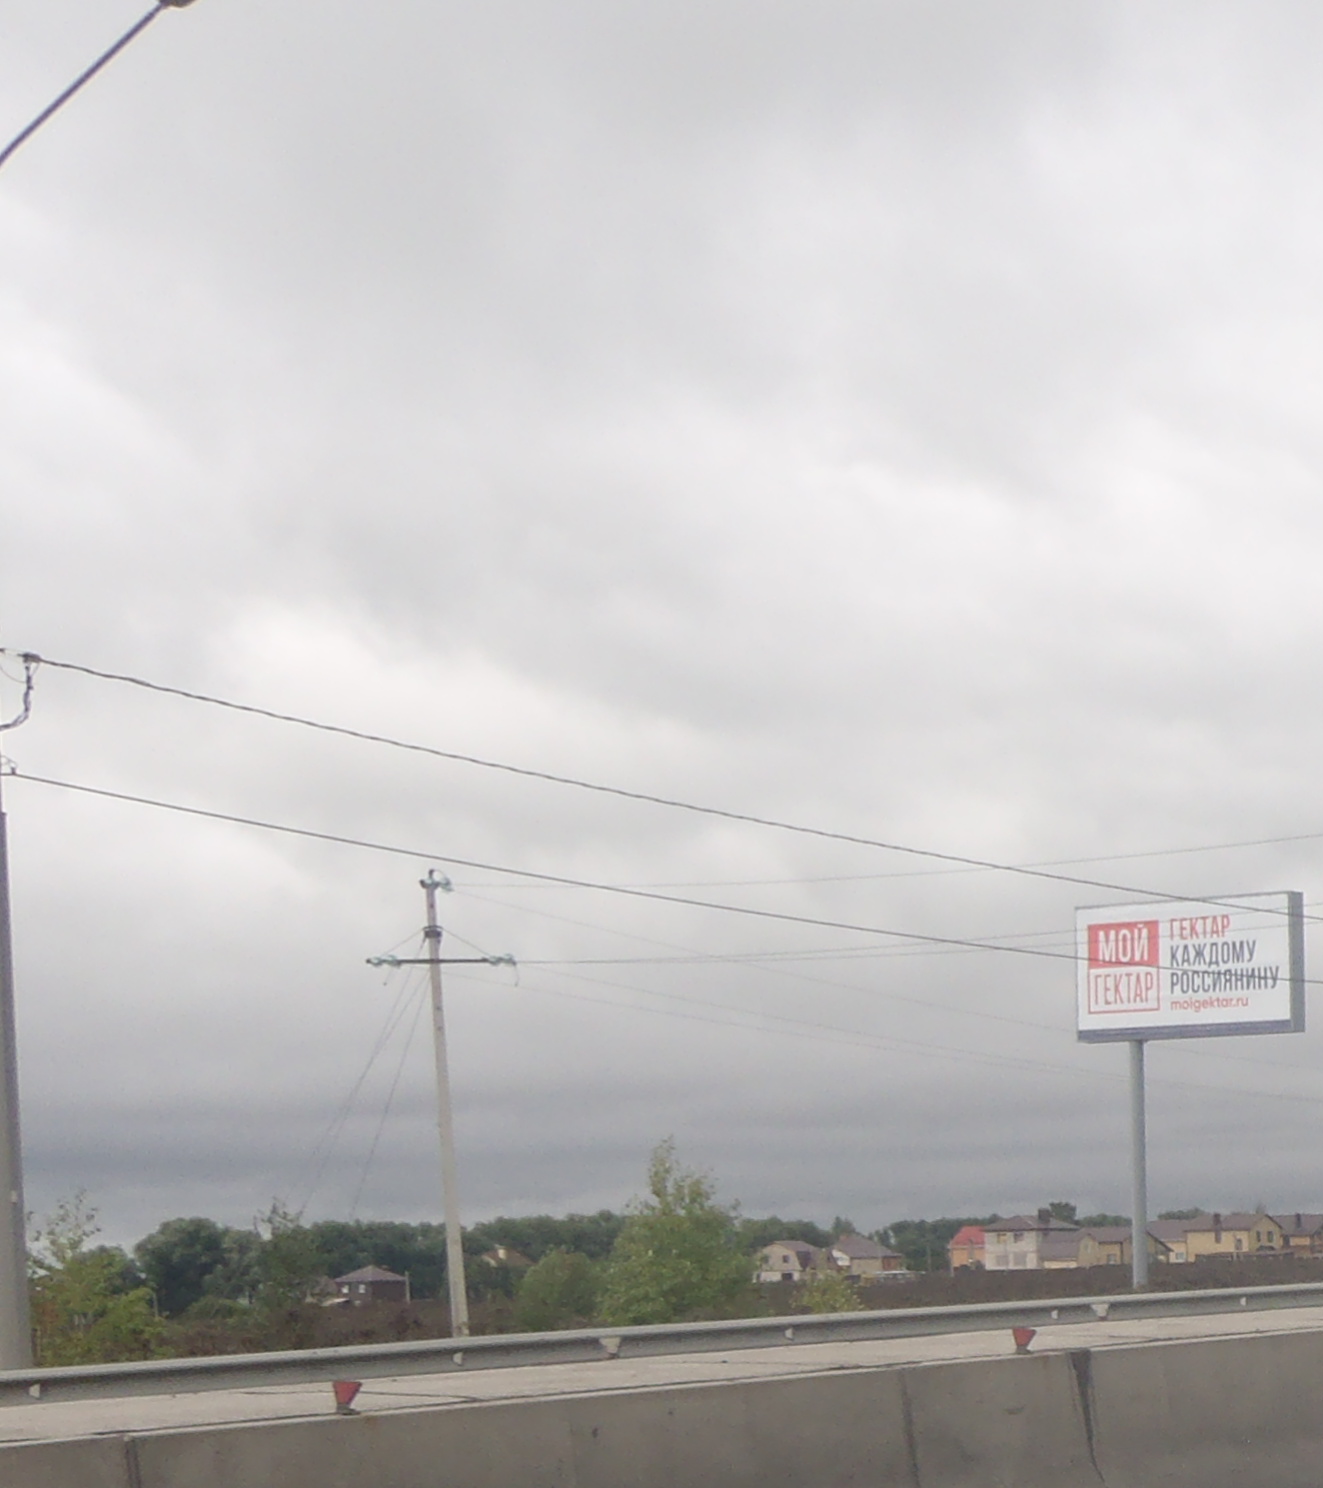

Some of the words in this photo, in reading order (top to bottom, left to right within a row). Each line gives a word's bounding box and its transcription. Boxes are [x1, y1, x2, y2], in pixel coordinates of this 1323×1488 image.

[1169, 914, 1231, 941] ГЕКТАР
[1098, 925, 1149, 964] МОЙ
[1170, 940, 1257, 969] КАЖДОМУ
[1094, 972, 1154, 1006] ГЕКТАР
[1170, 966, 1280, 995] РОССИЯНИНУ
[1170, 996, 1249, 1013] moigektar.ru
